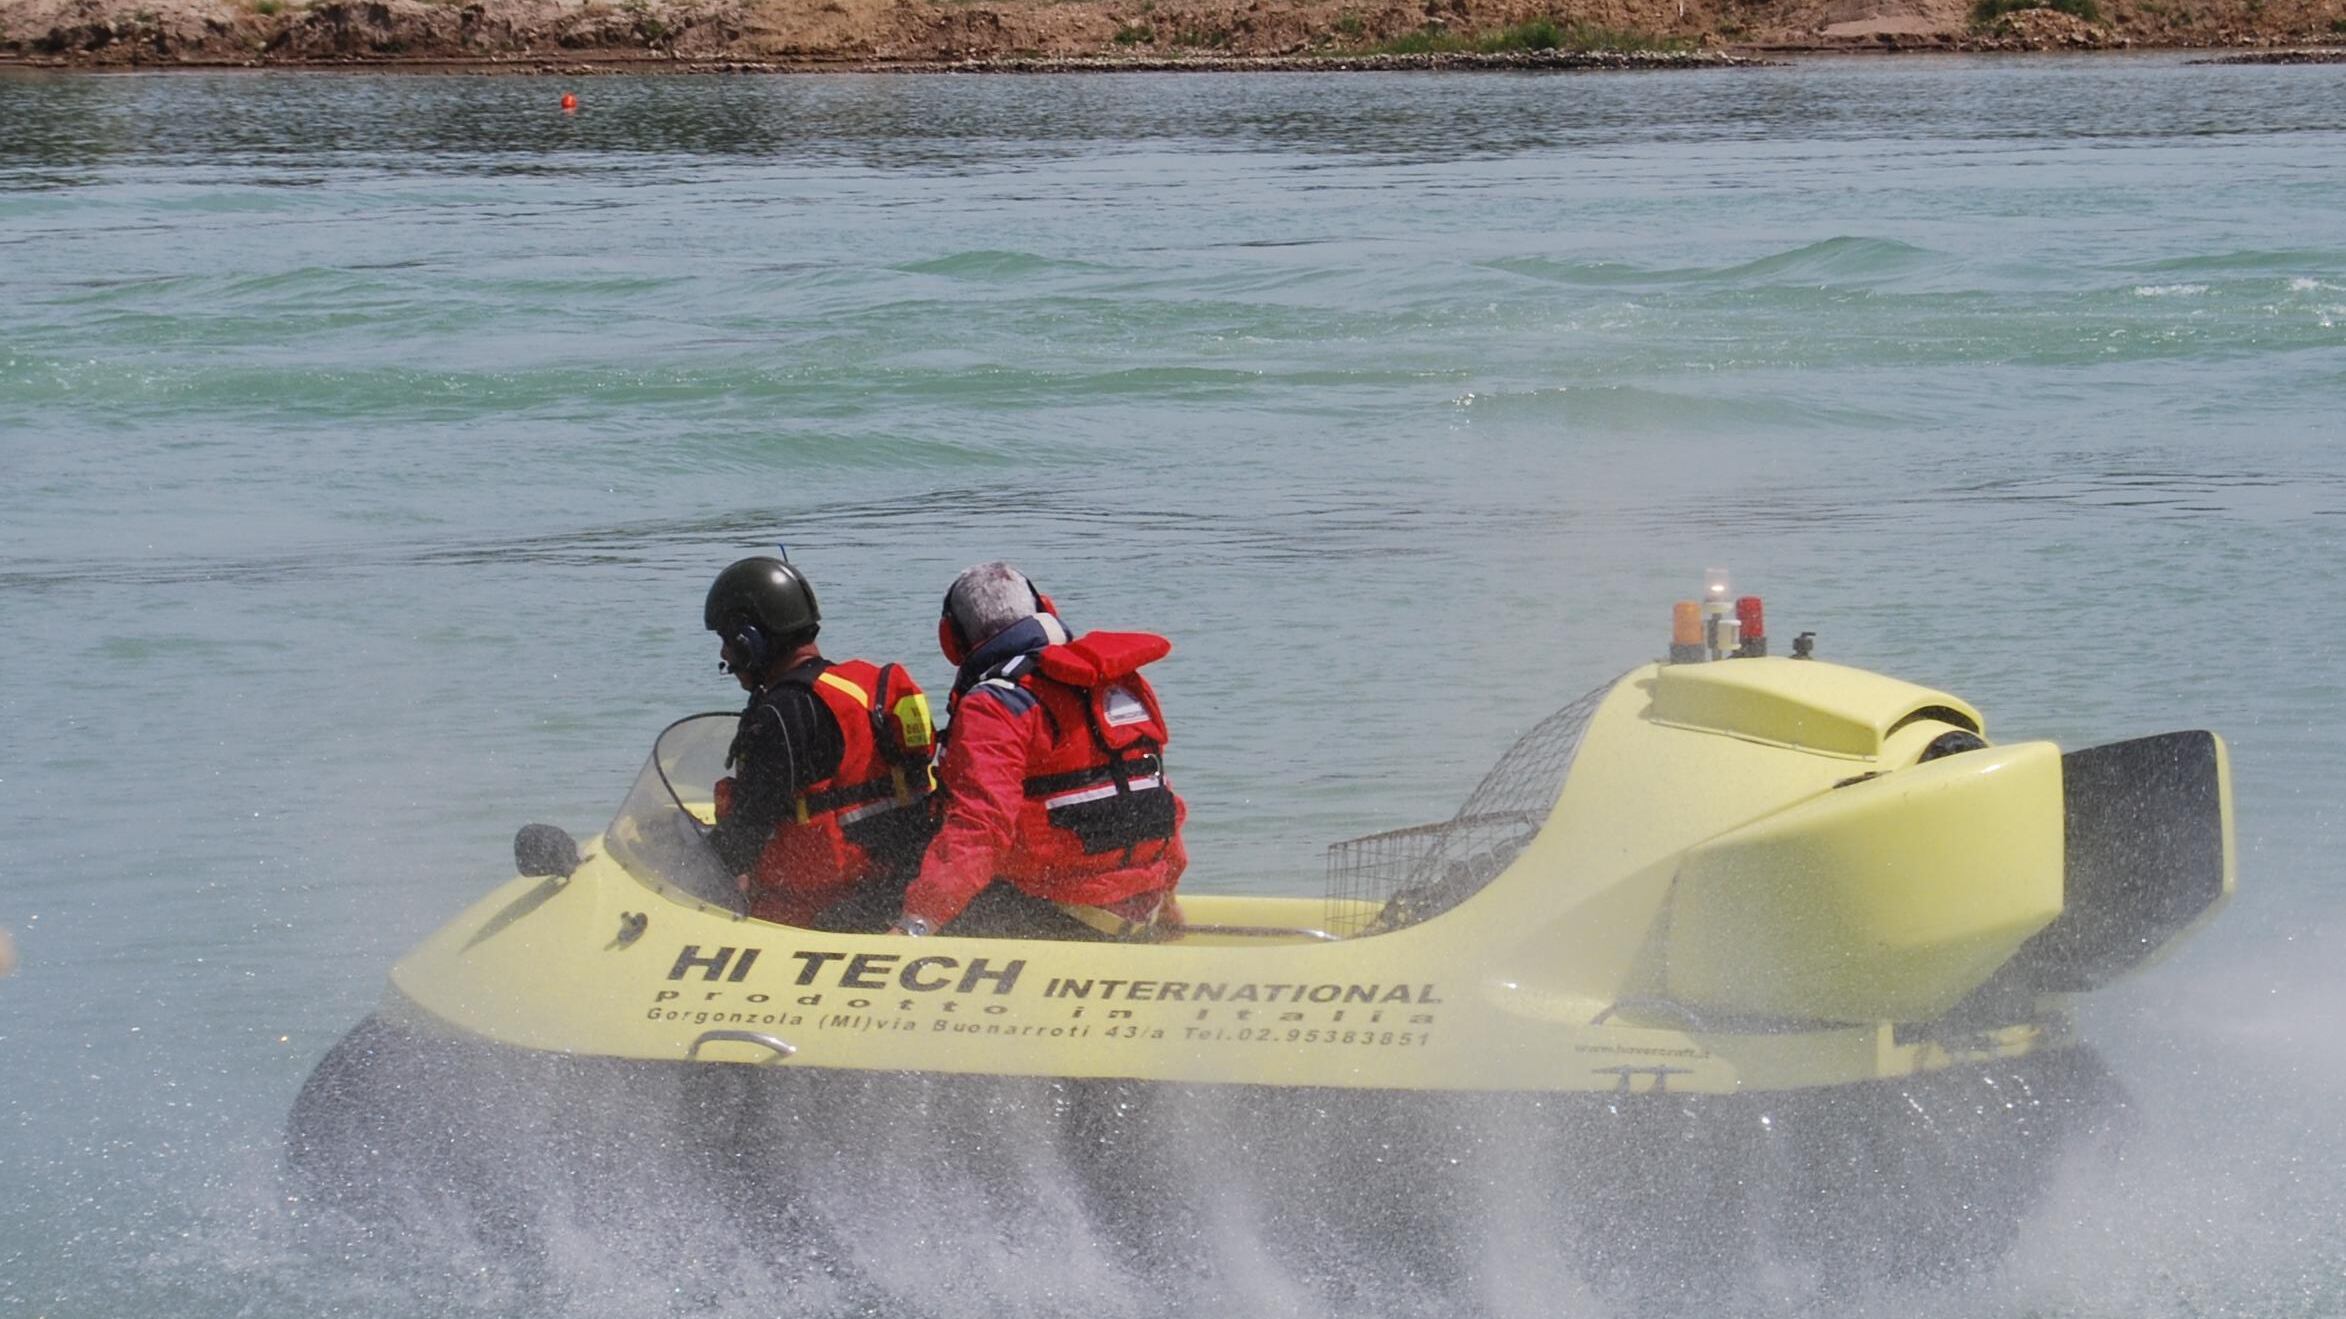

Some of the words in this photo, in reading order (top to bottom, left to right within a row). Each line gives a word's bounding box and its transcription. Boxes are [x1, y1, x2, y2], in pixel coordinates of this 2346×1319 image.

[666, 944, 763, 983] HI
[792, 951, 1027, 995] TECH
[1043, 978, 1443, 1005] INTERNATIONAL
[655, 990, 1010, 1015] prodotto
[1072, 1006, 1132, 1019] in
[646, 1007, 802, 1026] Gorgonzola
[932, 1020, 1090, 1040] Buonarroti
[1104, 1025, 1165, 1040] 43/a
